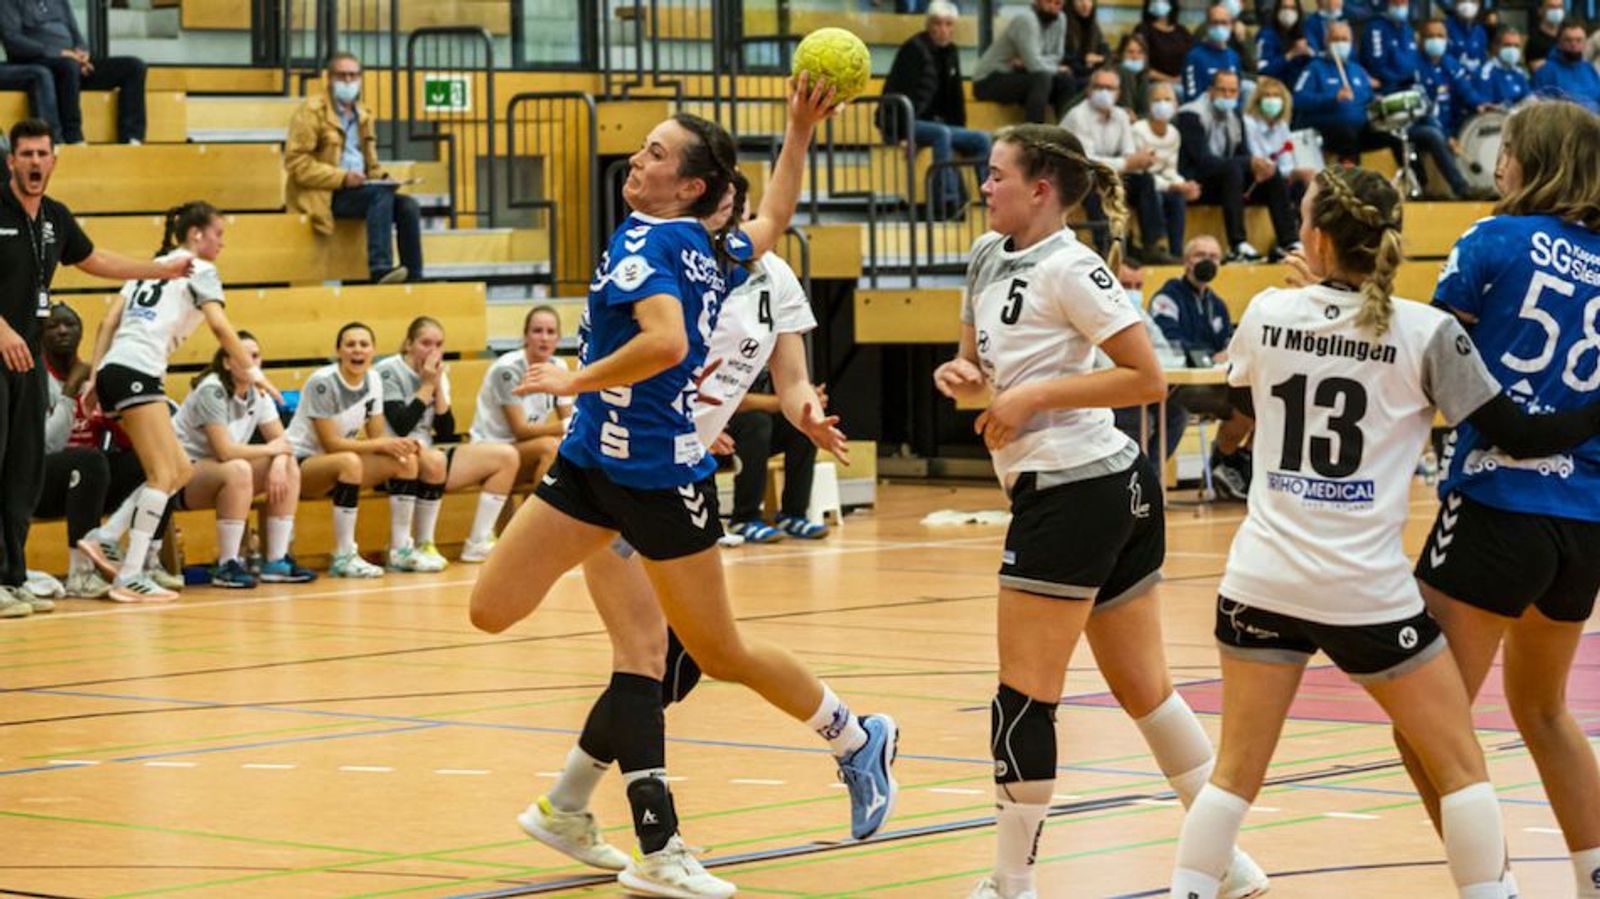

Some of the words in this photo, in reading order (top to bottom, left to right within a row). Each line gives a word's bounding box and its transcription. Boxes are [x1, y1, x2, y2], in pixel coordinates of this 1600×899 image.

[1530, 231, 1573, 274] SG
[759, 292, 774, 332] 4
[1001, 278, 1028, 325] 5
[1262, 325, 1282, 348] TV
[1285, 328, 1397, 364] Möglingen
[1501, 269, 1600, 392] 58
[1271, 373, 1368, 478] 13
